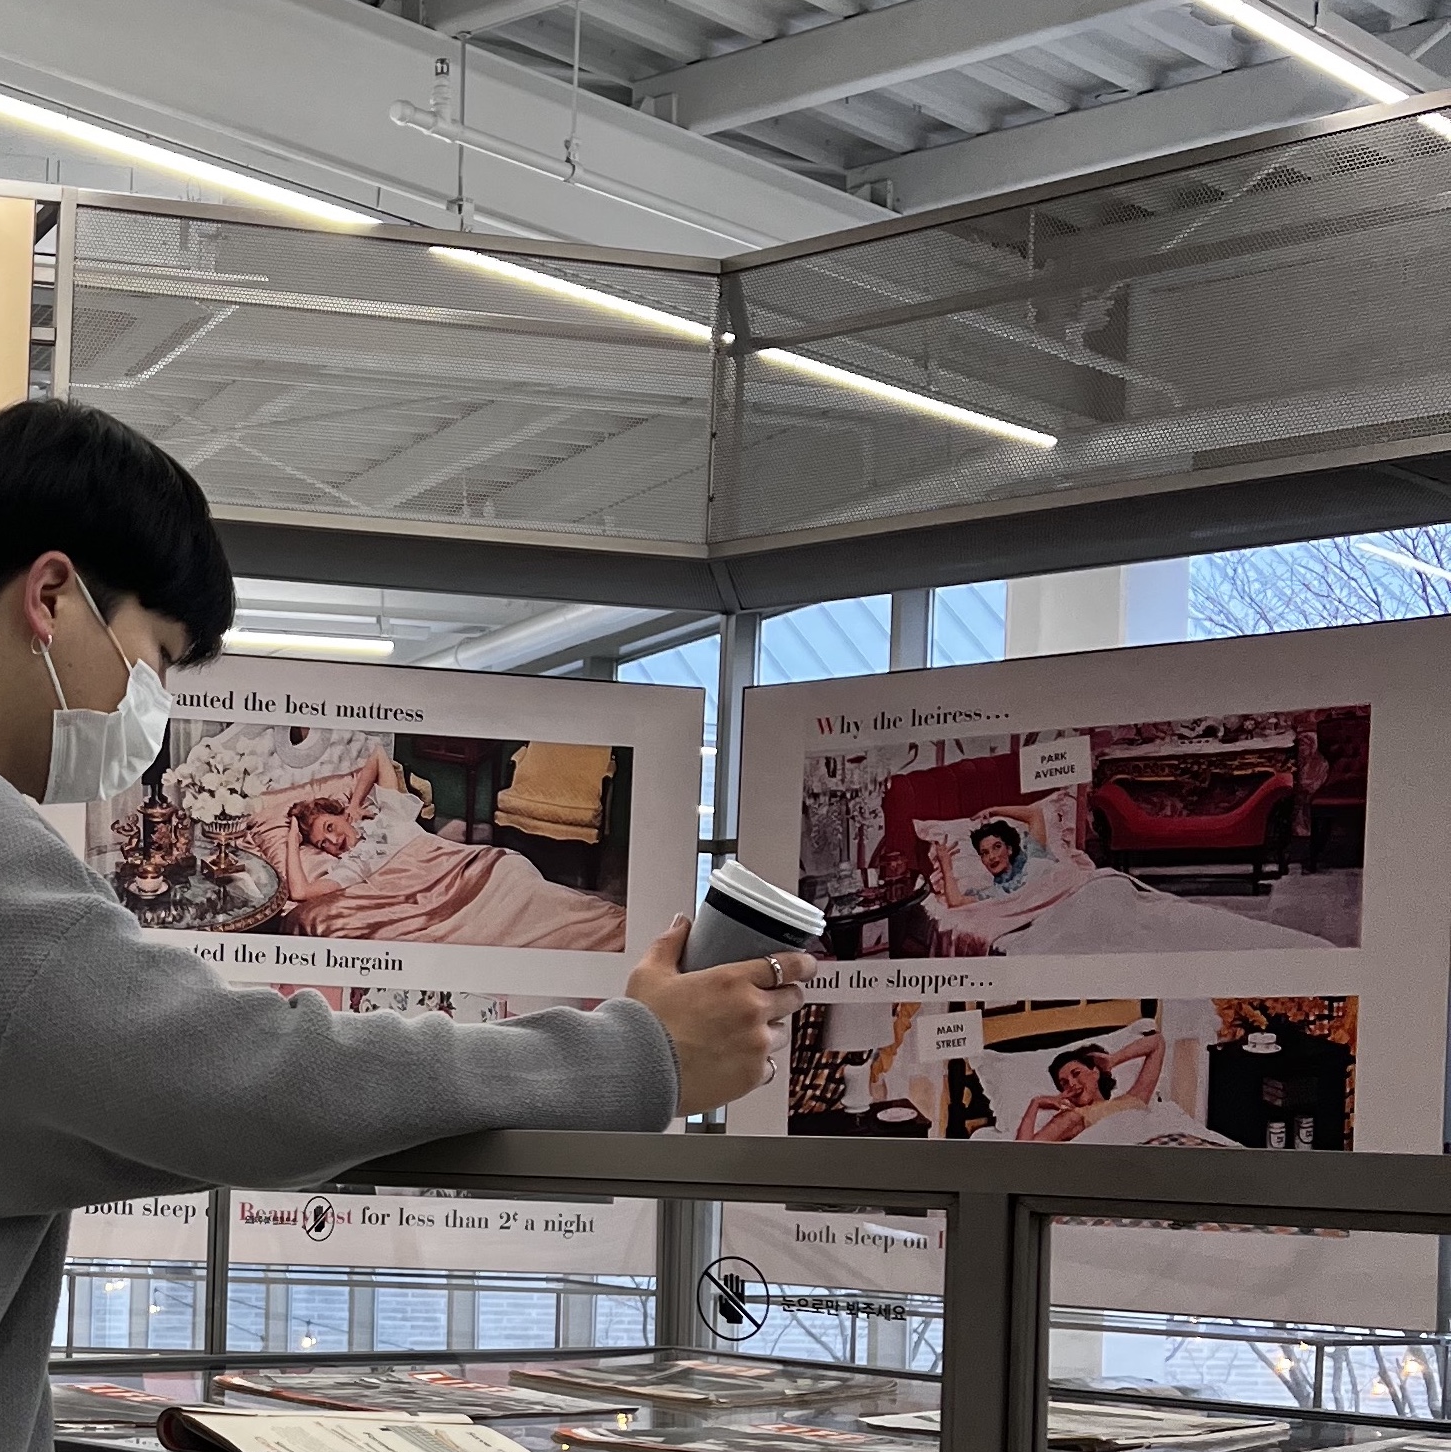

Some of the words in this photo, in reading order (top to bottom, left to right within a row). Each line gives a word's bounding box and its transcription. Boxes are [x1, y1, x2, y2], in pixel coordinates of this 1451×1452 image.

[172, 691, 235, 710] anted
[244, 692, 276, 713] the
[284, 694, 327, 717] best
[336, 702, 424, 723] mattress
[816, 715, 864, 740] Why
[873, 711, 903, 731] the
[911, 705, 1011, 728] heiress...
[1040, 751, 1068, 765] PARK
[1034, 764, 1076, 780] AVENUE
[191, 943, 225, 962] ted
[234, 944, 267, 964] the
[275, 946, 317, 967] best
[326, 949, 403, 976] bargain
[805, 971, 840, 989] and
[848, 970, 879, 989] the
[886, 969, 994, 994] shopper...
[936, 1023, 964, 1036] MAIN
[935, 1036, 967, 1050] STREET
[142, 1198, 197, 1225] sleep
[238, 1202, 353, 1230] Beautyest
[361, 1206, 390, 1226] for
[398, 1207, 435, 1228] less
[445, 1209, 489, 1230] than
[524, 1219, 535, 1231] a
[543, 1213, 595, 1239] night
[794, 1223, 836, 1245] both
[844, 1225, 895, 1253] sleep
[903, 1235, 928, 1250] on
[781, 1296, 839, 1317] 눈으로만
[846, 1300, 907, 1322] 봐주세요
